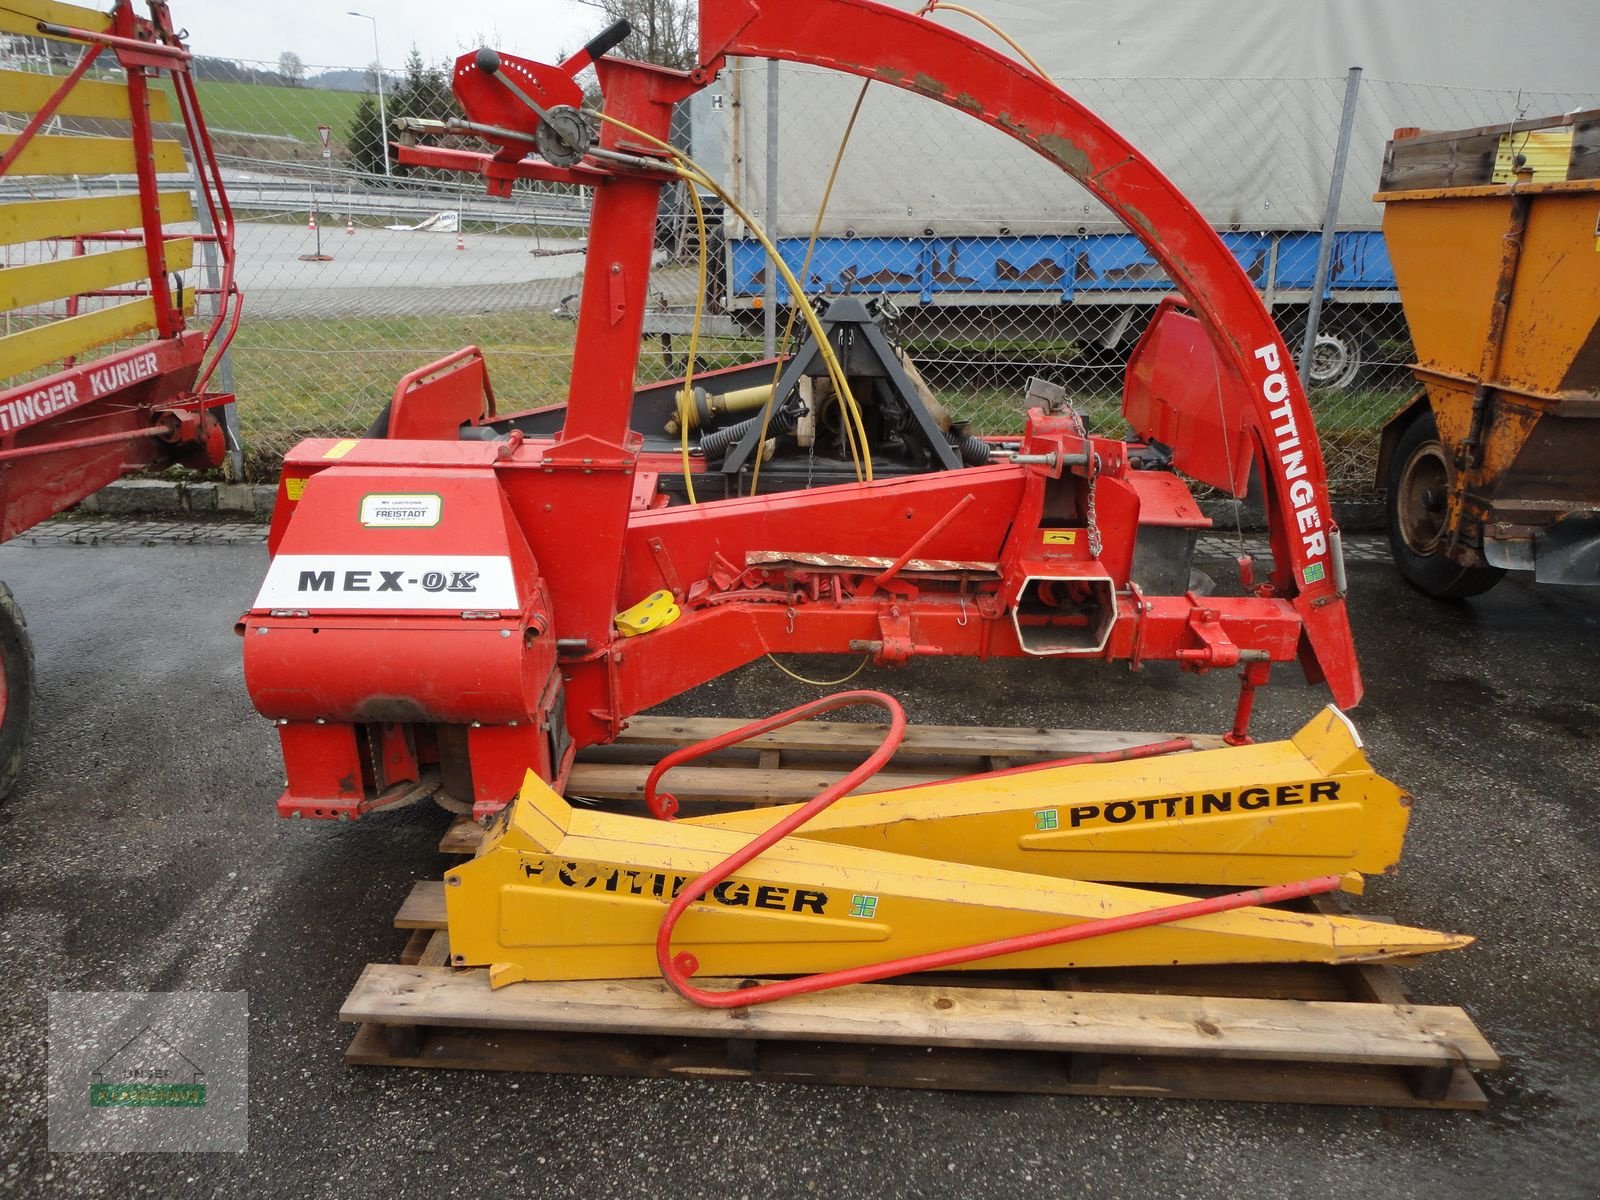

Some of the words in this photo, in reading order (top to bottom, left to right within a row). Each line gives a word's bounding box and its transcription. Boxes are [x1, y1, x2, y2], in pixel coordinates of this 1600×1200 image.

[89, 352, 159, 396] KURIER
[375, 510, 427, 518] FREISTADT
[297, 571, 480, 592] MEX-OK
